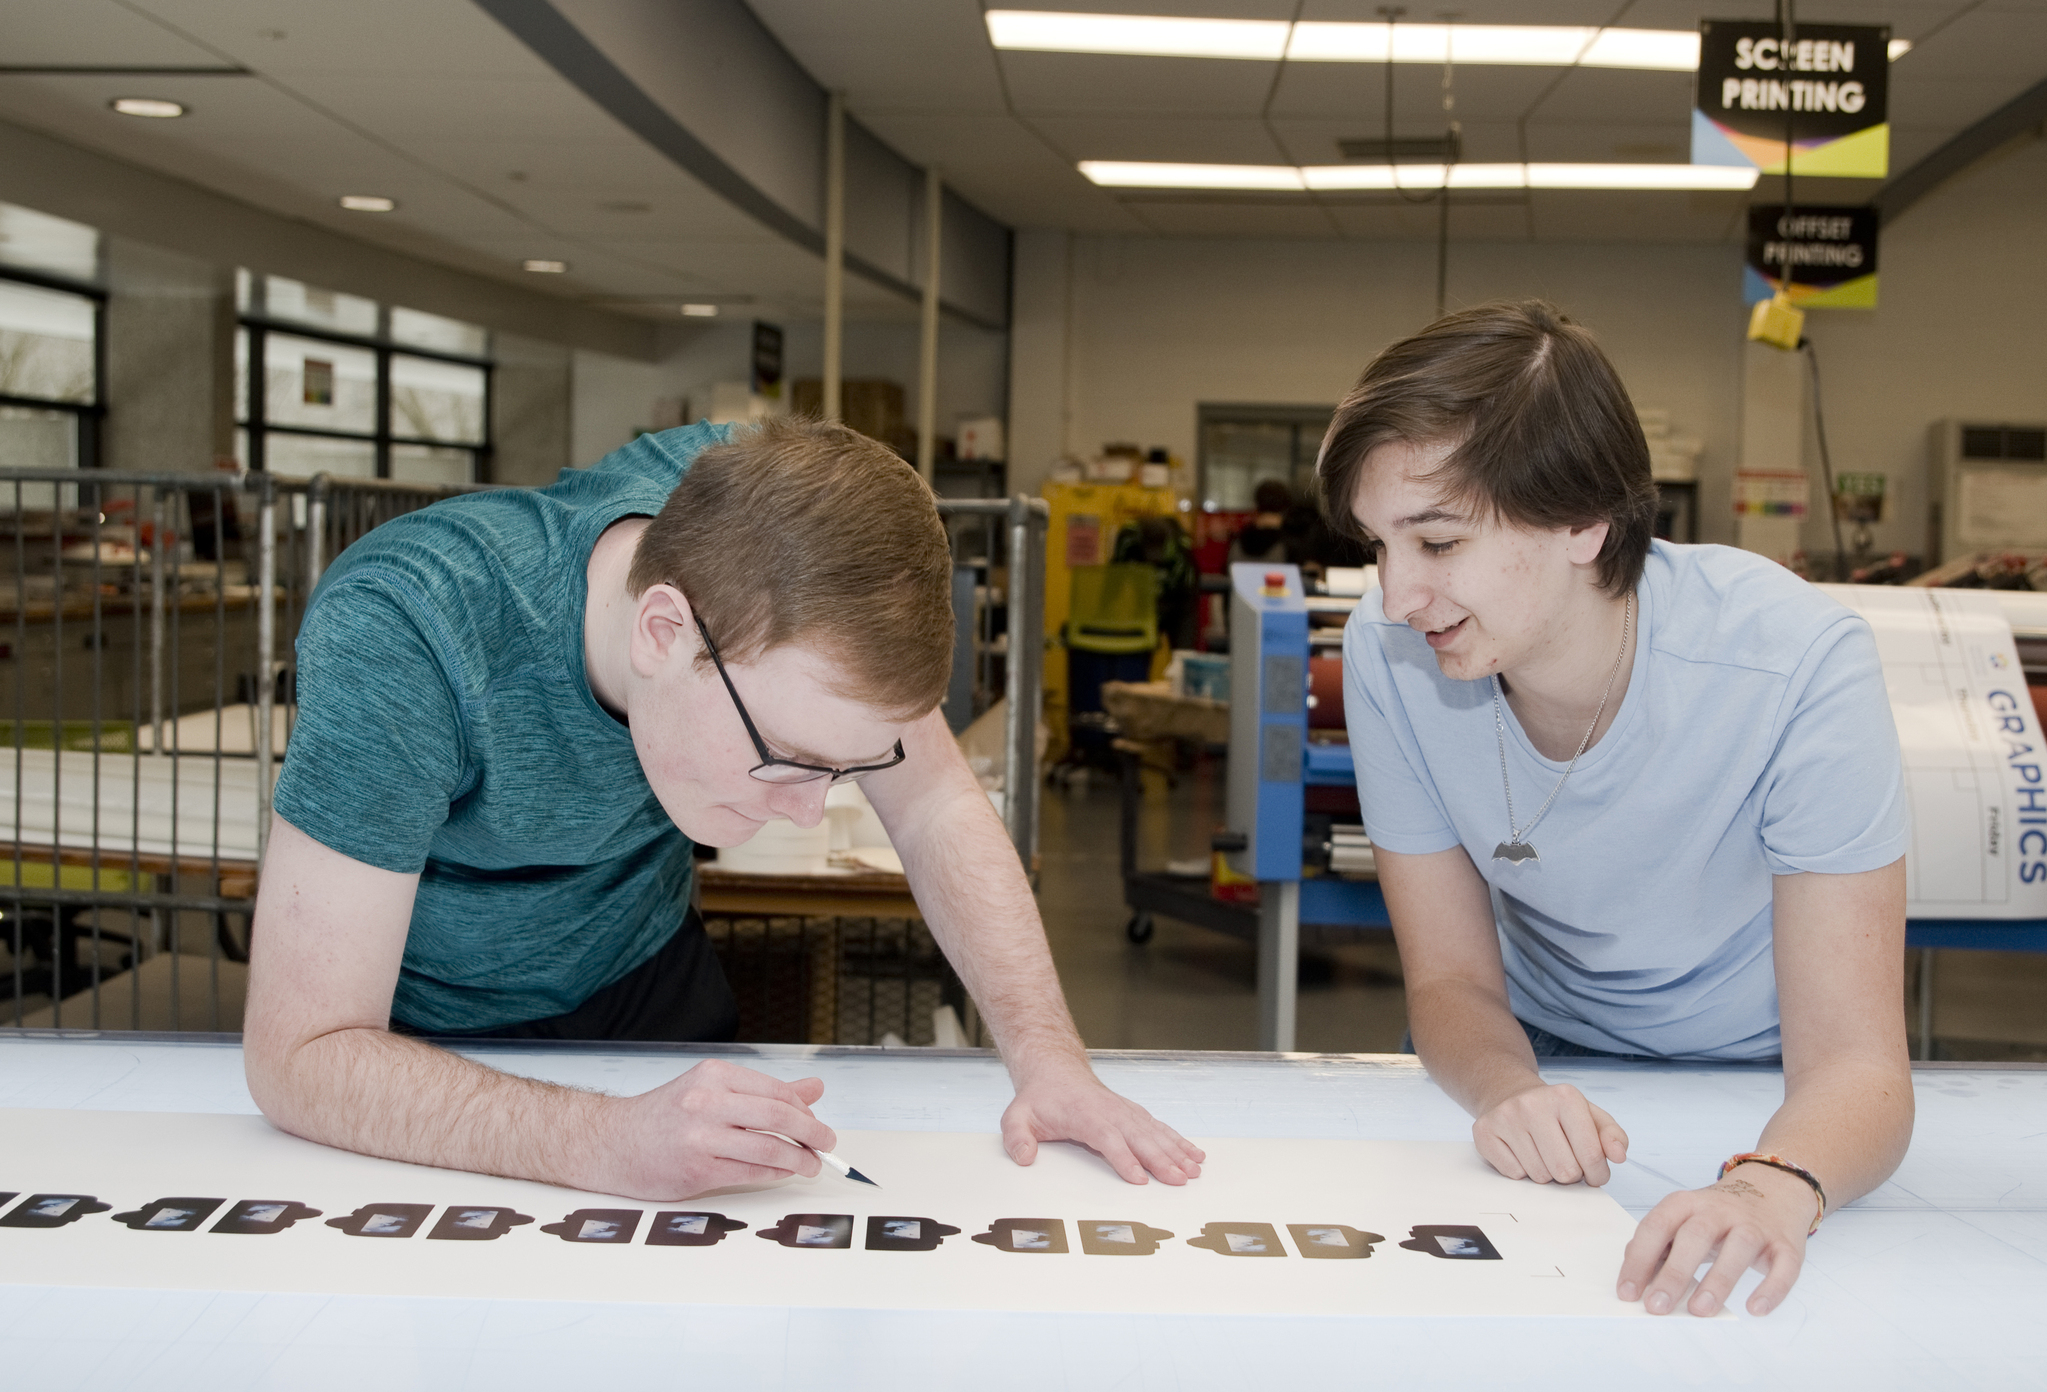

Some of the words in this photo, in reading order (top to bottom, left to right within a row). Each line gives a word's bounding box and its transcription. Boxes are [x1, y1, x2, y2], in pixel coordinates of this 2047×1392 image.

[1722, 78, 1866, 113] PRINTING
[1777, 216, 1852, 240] OFFSET
[1763, 241, 1863, 267] PRINTING
[1986, 690, 2047, 884] GRAPHICS
[1987, 806, 2001, 858] Friday
